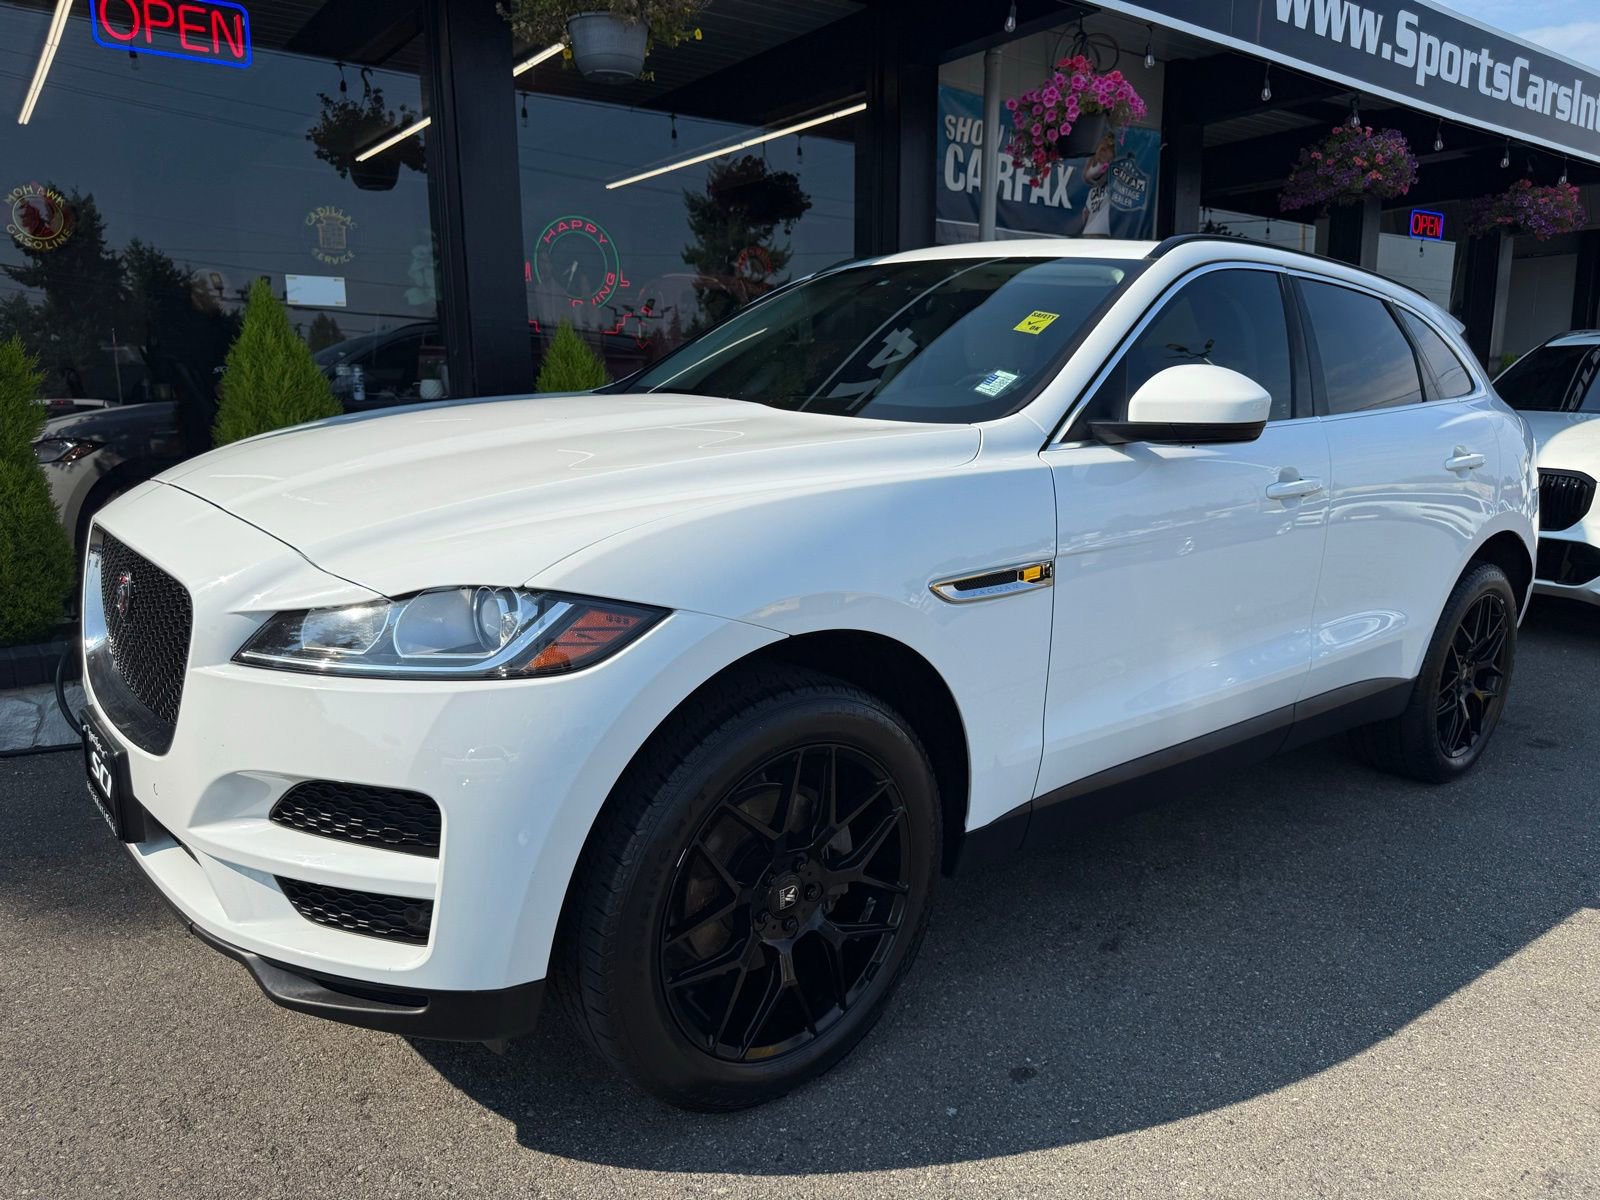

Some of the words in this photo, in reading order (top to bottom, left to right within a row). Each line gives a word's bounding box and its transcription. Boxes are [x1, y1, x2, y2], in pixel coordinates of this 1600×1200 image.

[100, 0, 244, 58] OPEN
[944, 143, 1077, 209] CARFAX
[4, 184, 65, 207] MOHAWK
[6, 223, 74, 250] GASOLINE
[544, 220, 608, 243] HAPPY
[1413, 213, 1442, 237] OPEN
[970, 582, 1020, 597] JAGUAR
